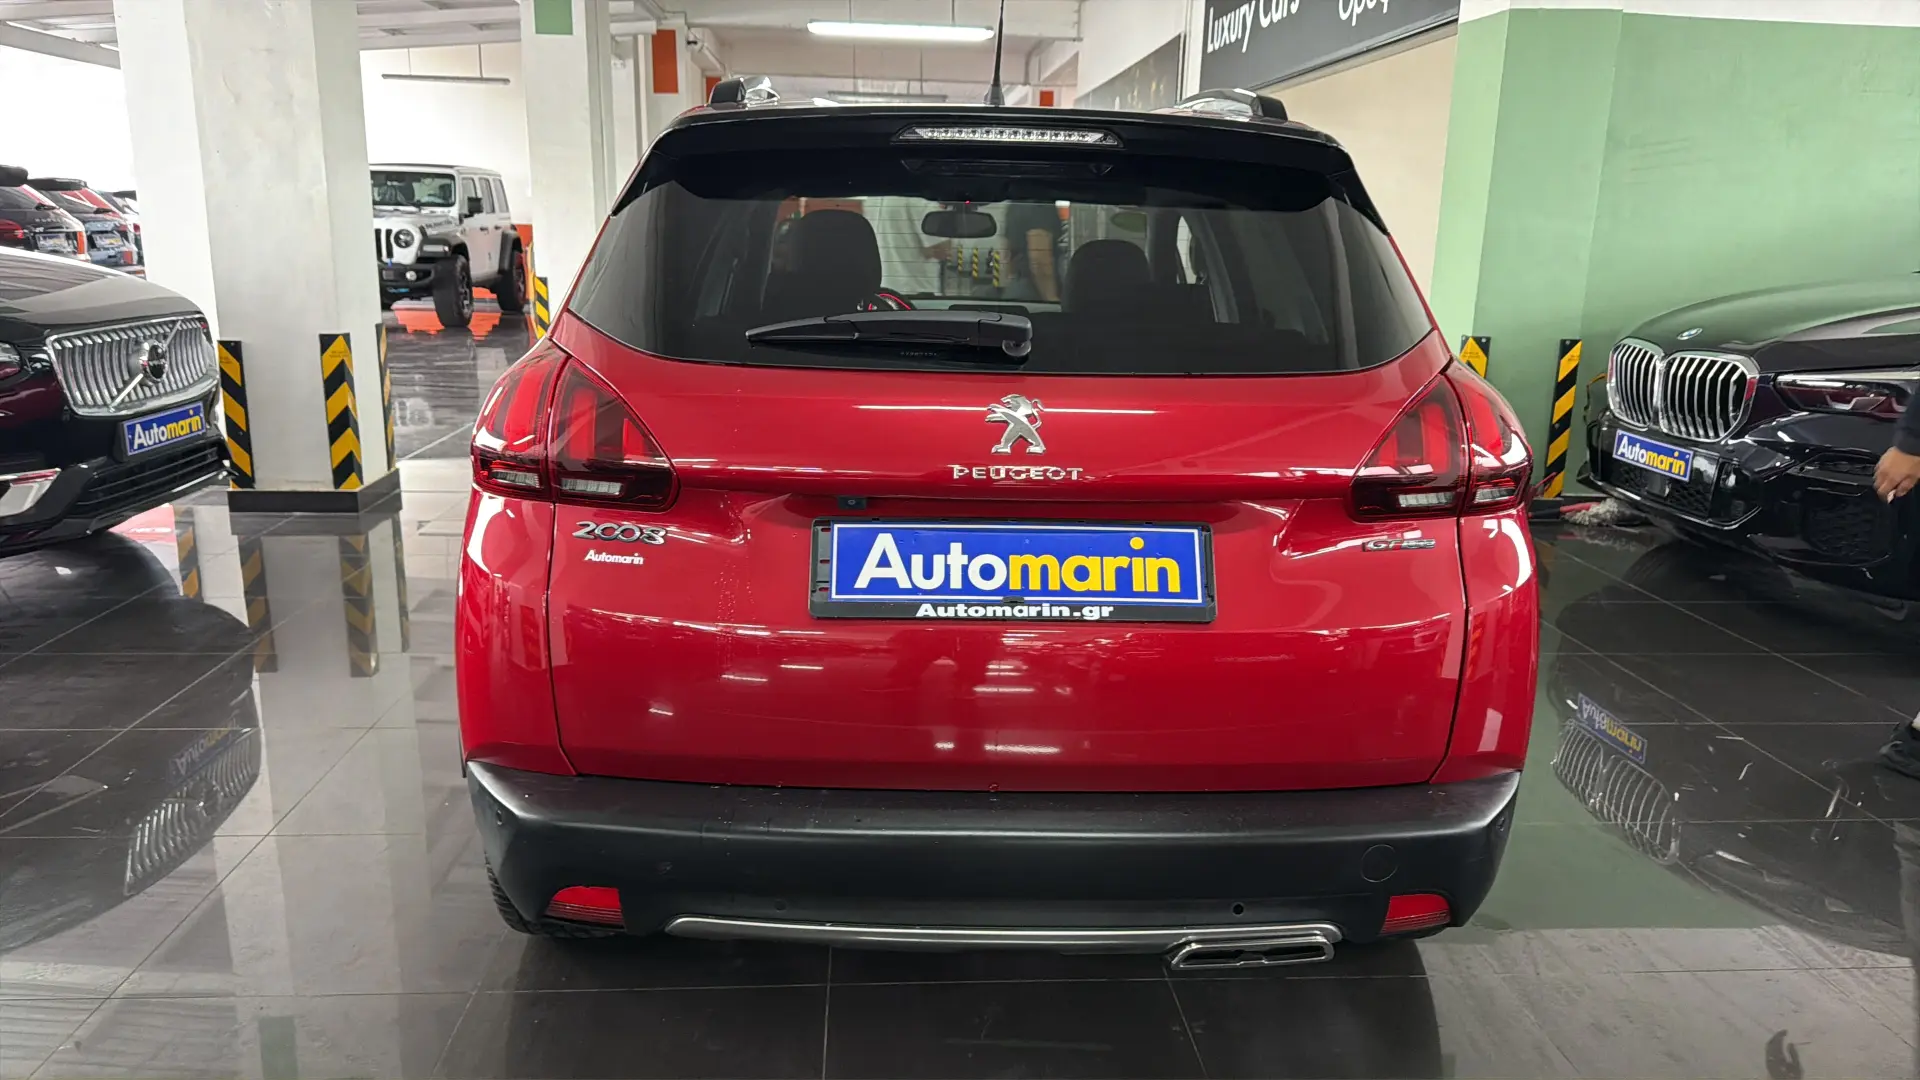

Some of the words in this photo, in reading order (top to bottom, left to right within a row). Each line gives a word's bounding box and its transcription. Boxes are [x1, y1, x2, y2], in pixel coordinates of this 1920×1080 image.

[1206, 0, 1256, 53] Luxury
[133, 409, 202, 450] Automarin
[1617, 435, 1686, 476] Automarin
[951, 465, 1084, 480] PEUGEOT
[572, 521, 667, 545] 2008
[584, 549, 644, 565] Automarin
[853, 532, 1181, 593] Automarin
[916, 602, 1115, 621] Automarin.gr
